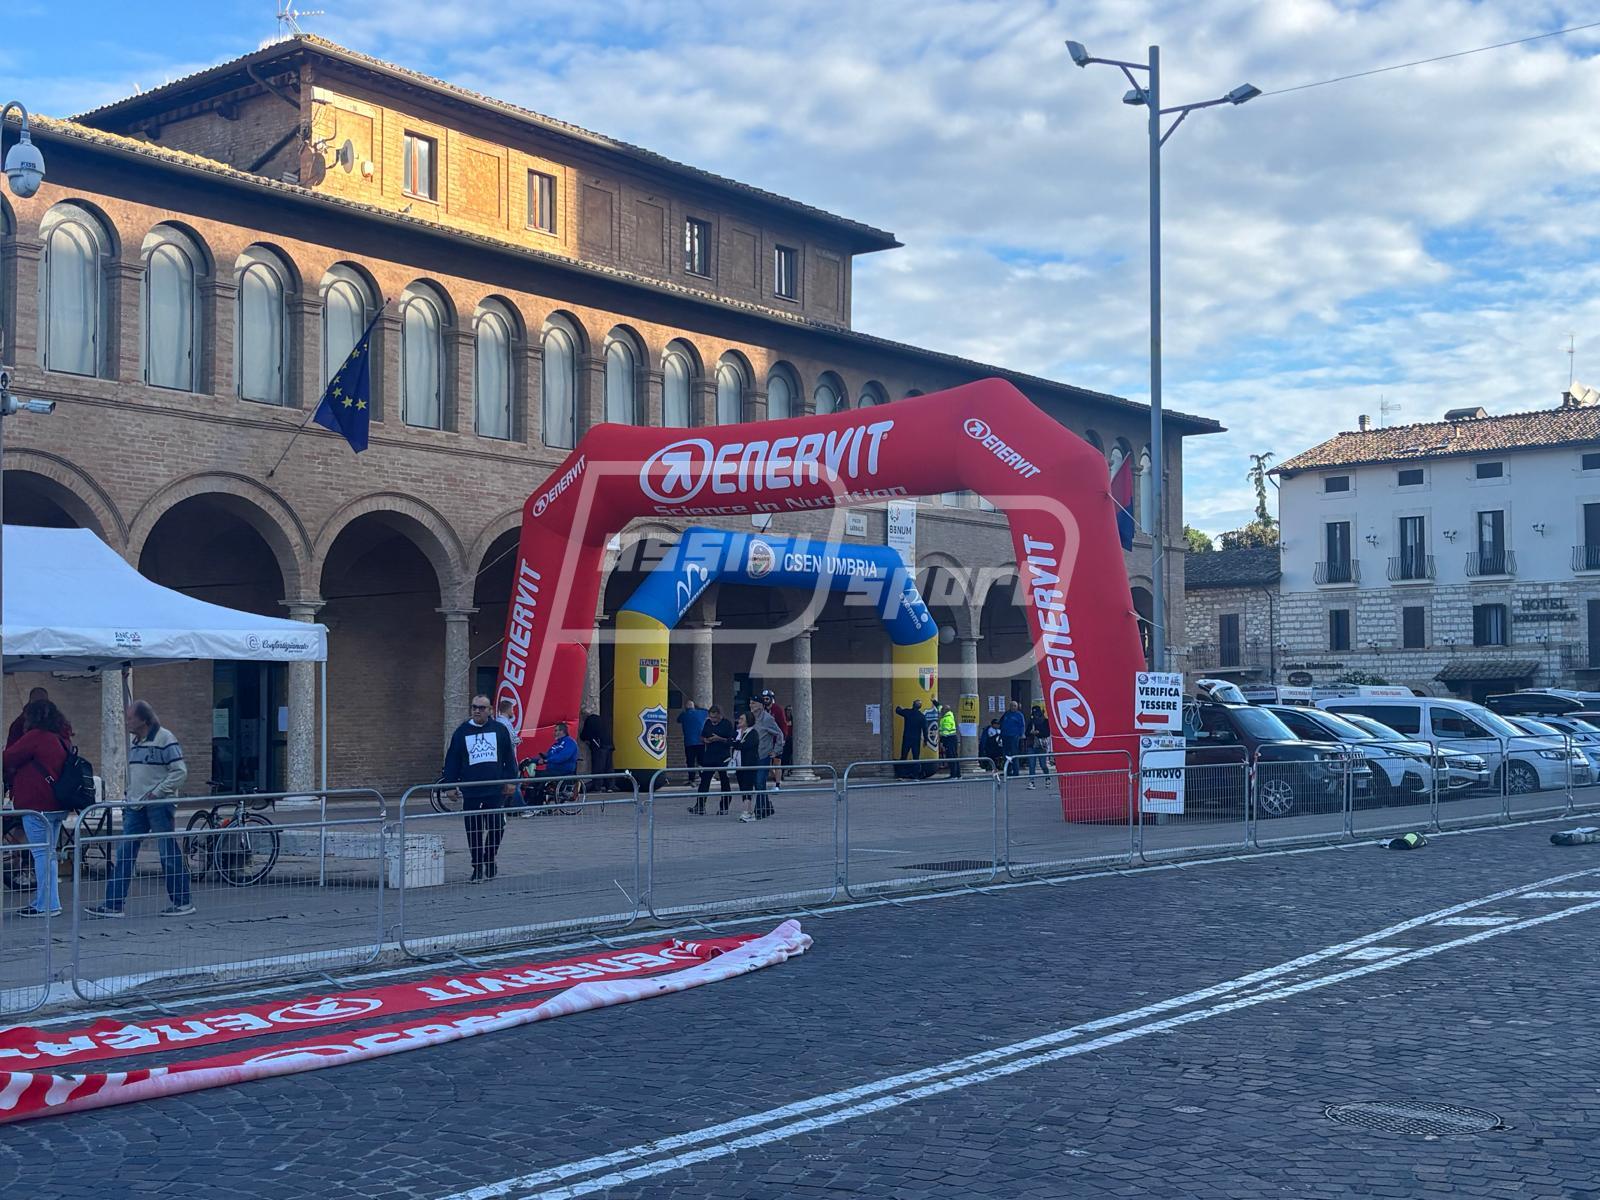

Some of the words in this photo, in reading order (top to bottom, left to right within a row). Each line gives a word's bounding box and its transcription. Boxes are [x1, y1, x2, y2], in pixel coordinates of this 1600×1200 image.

[712, 420, 894, 494] ENERVIT
[982, 433, 1041, 478] ENERVIT
[548, 454, 586, 503] ENERVIT
[654, 505, 747, 517] Science
[755, 501, 780, 512] in
[785, 486, 907, 511] Nutrition
[784, 553, 822, 573] CSEN
[827, 556, 878, 578] UMBRIA
[503, 558, 542, 687] ENERVIT
[1023, 533, 1080, 682] ENERVIT
[1521, 599, 1569, 611] HOTEL
[1139, 687, 1180, 697] VERIFICA
[1140, 700, 1178, 711] TESSERE
[1142, 767, 1182, 779] RITROVO
[416, 953, 674, 1001] ENERVIT
